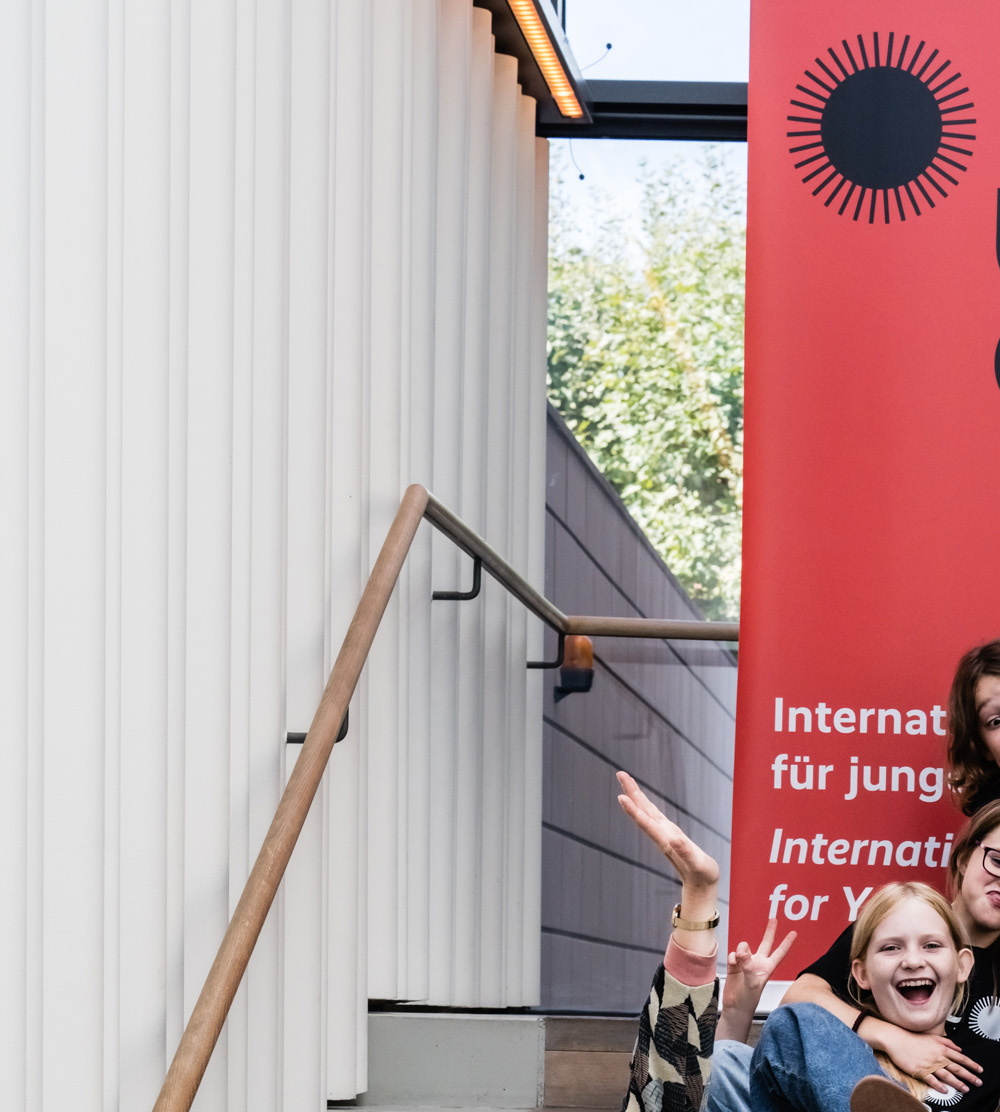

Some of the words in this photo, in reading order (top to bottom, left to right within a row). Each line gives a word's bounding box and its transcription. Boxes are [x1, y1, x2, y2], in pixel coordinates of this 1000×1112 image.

[774, 697, 947, 736] Internat
[771, 753, 834, 790] für
[844, 756, 944, 802] jung
[769, 828, 954, 868] Internati
[768, 883, 829, 921] for
